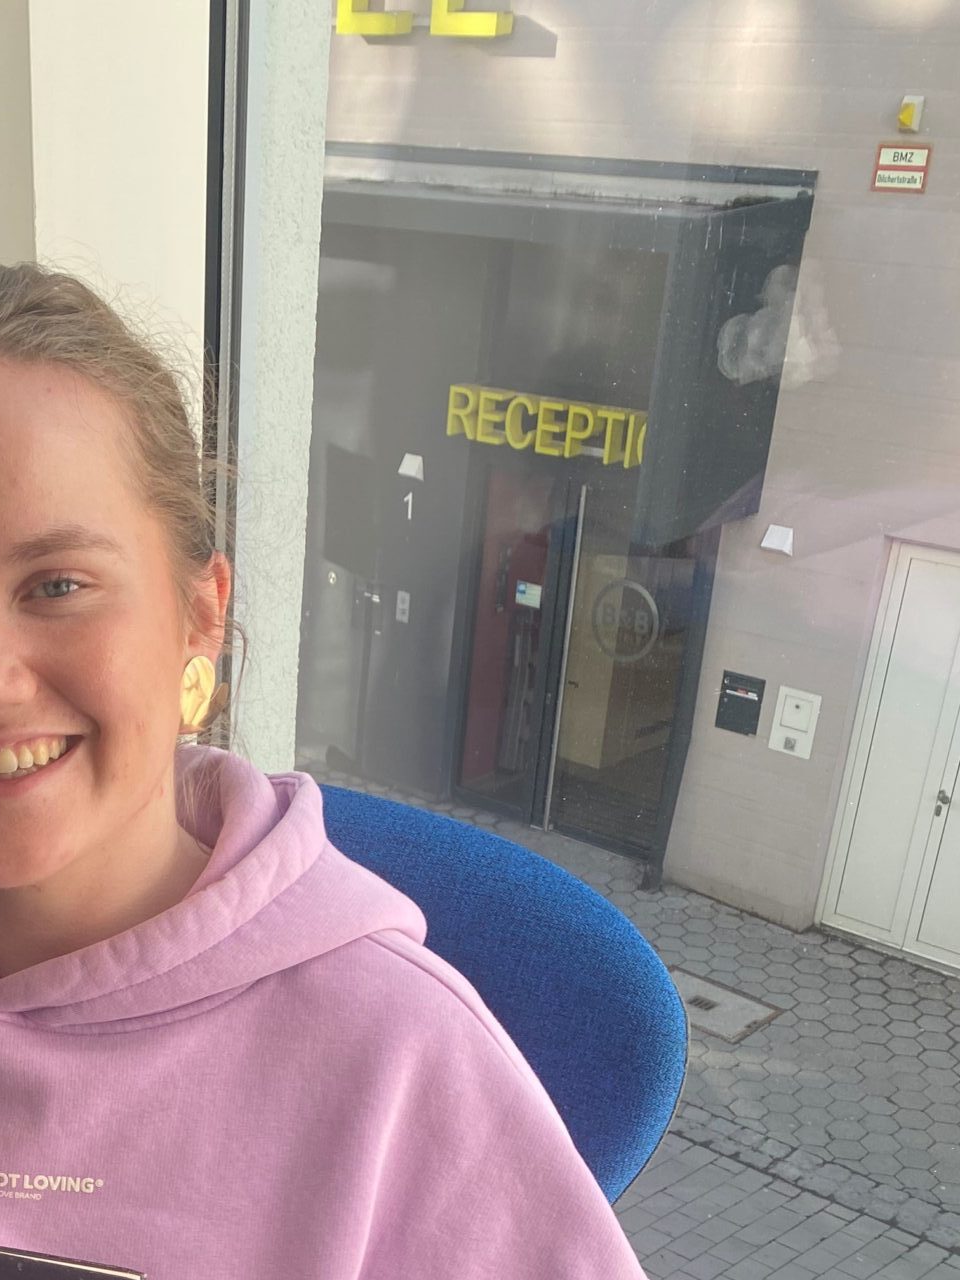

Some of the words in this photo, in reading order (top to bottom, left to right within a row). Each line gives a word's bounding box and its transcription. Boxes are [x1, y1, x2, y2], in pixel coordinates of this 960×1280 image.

[892, 151, 914, 163] BMZ
[403, 491, 413, 520] 1
[14, 1191, 42, 1200] BRAND
